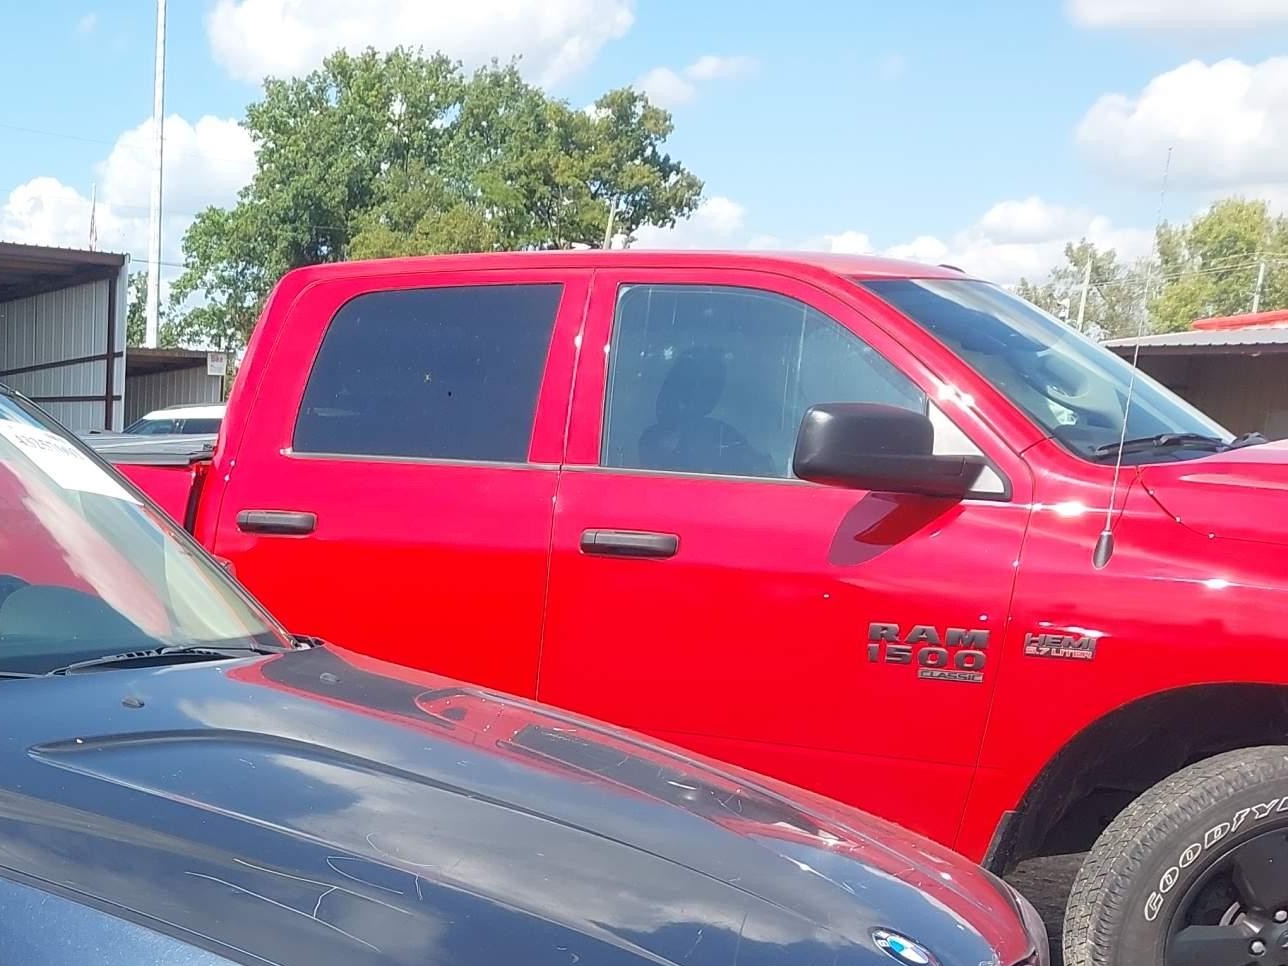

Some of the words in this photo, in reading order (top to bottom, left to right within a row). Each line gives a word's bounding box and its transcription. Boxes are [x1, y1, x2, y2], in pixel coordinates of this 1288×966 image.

[867, 622, 991, 649] RAM
[1024, 632, 1097, 651] HEMI
[867, 643, 987, 671] 1500
[1025, 646, 1050, 656] 5.7
[1051, 648, 1093, 659] LITER
[919, 668, 983, 682] CLASSIC
